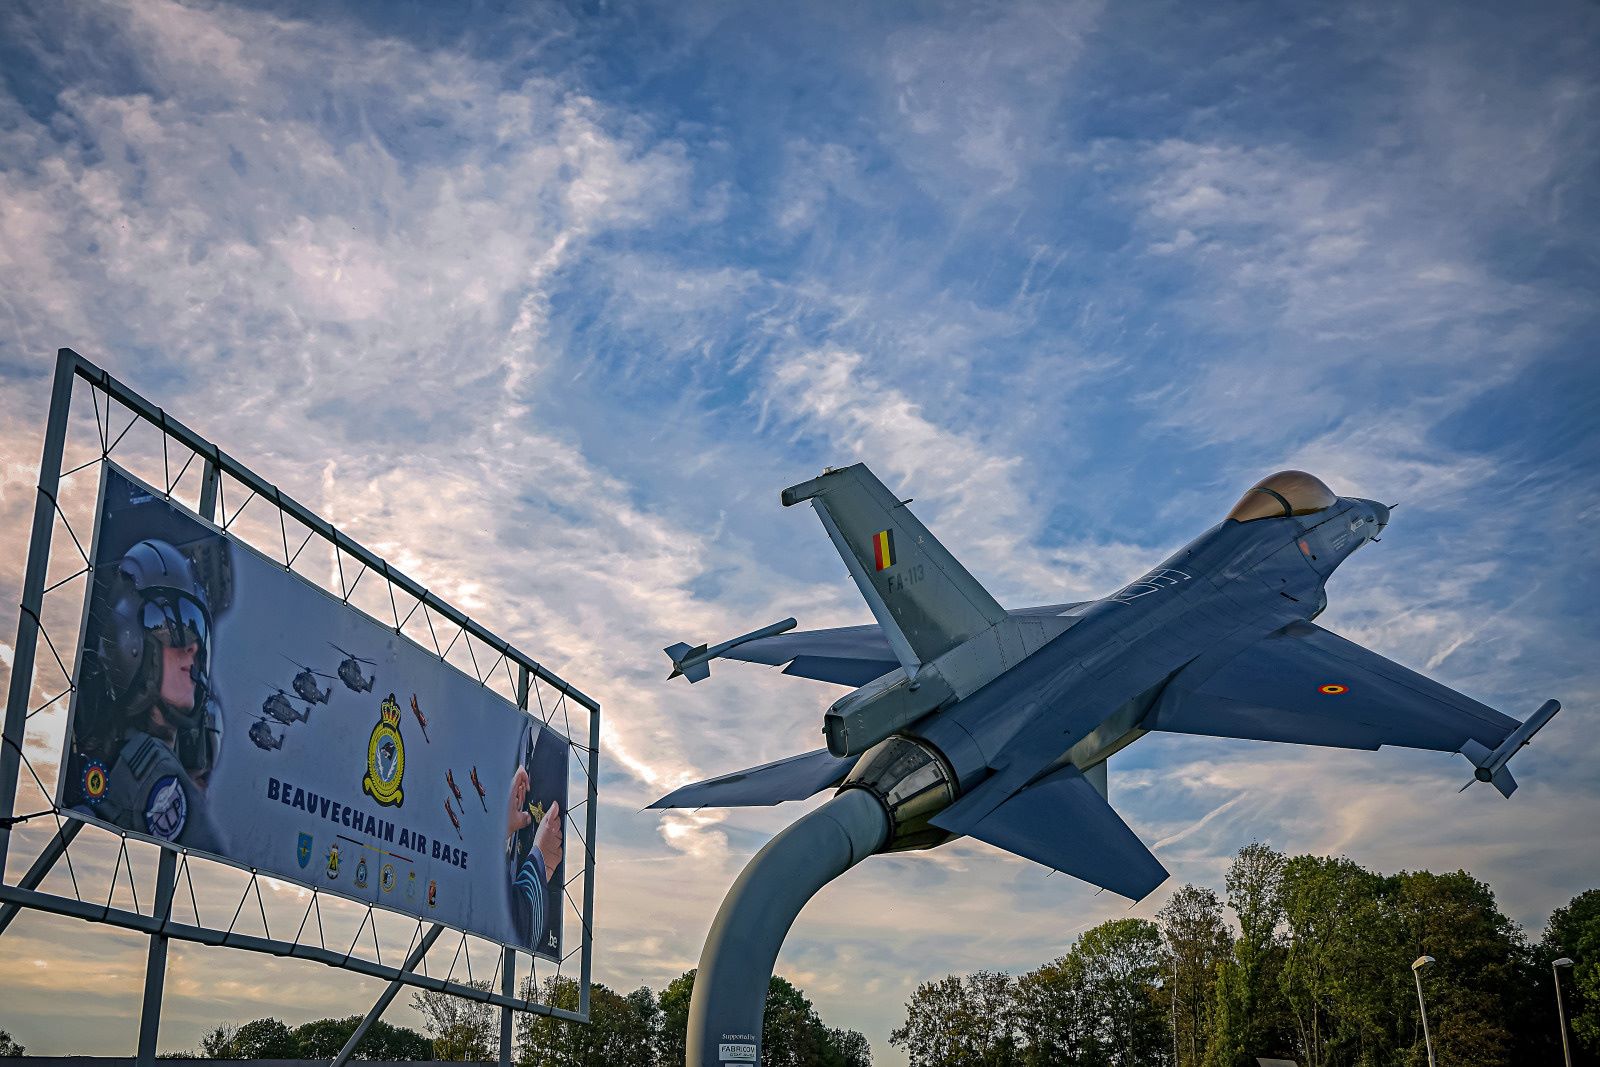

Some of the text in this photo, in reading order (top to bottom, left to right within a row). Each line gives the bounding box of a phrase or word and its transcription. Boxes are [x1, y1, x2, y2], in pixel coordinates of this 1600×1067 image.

[887, 564, 925, 593] FA-113
[267, 777, 468, 869] BEAUVECHAIN AIR BASE
